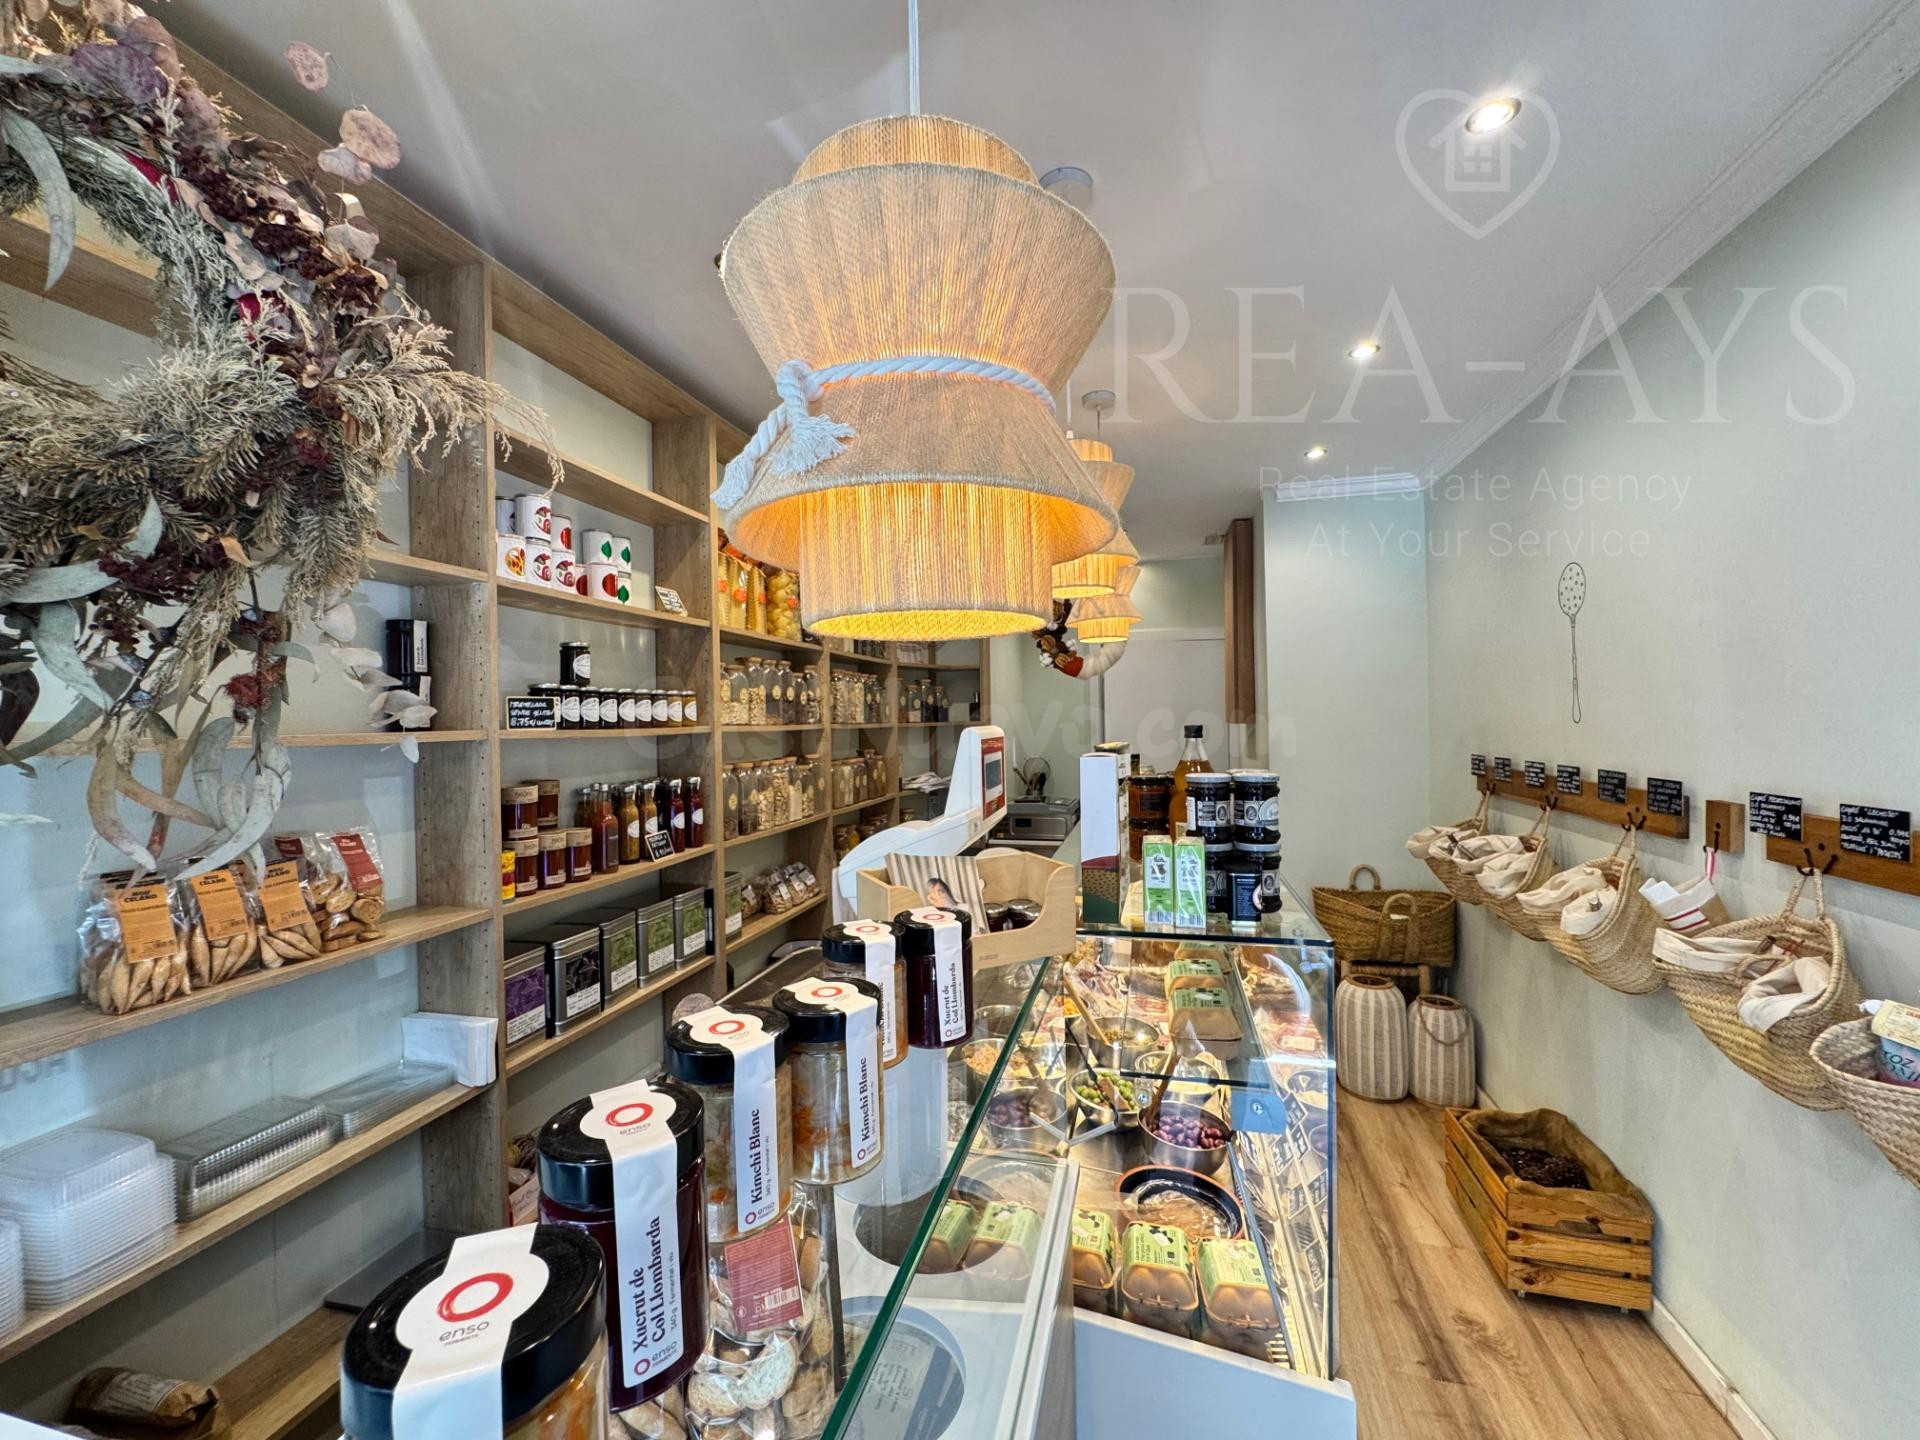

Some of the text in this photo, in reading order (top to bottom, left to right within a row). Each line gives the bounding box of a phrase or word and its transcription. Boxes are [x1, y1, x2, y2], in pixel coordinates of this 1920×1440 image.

[859, 1057, 870, 1142] Kimchi Blanc
[749, 1108, 762, 1204] Kimchi Blanc
[629, 1267, 648, 1353] Xucrut de
[646, 1216, 665, 1343] Col Llombarda
[439, 1321, 490, 1342] enso
[651, 1341, 677, 1362] enso
